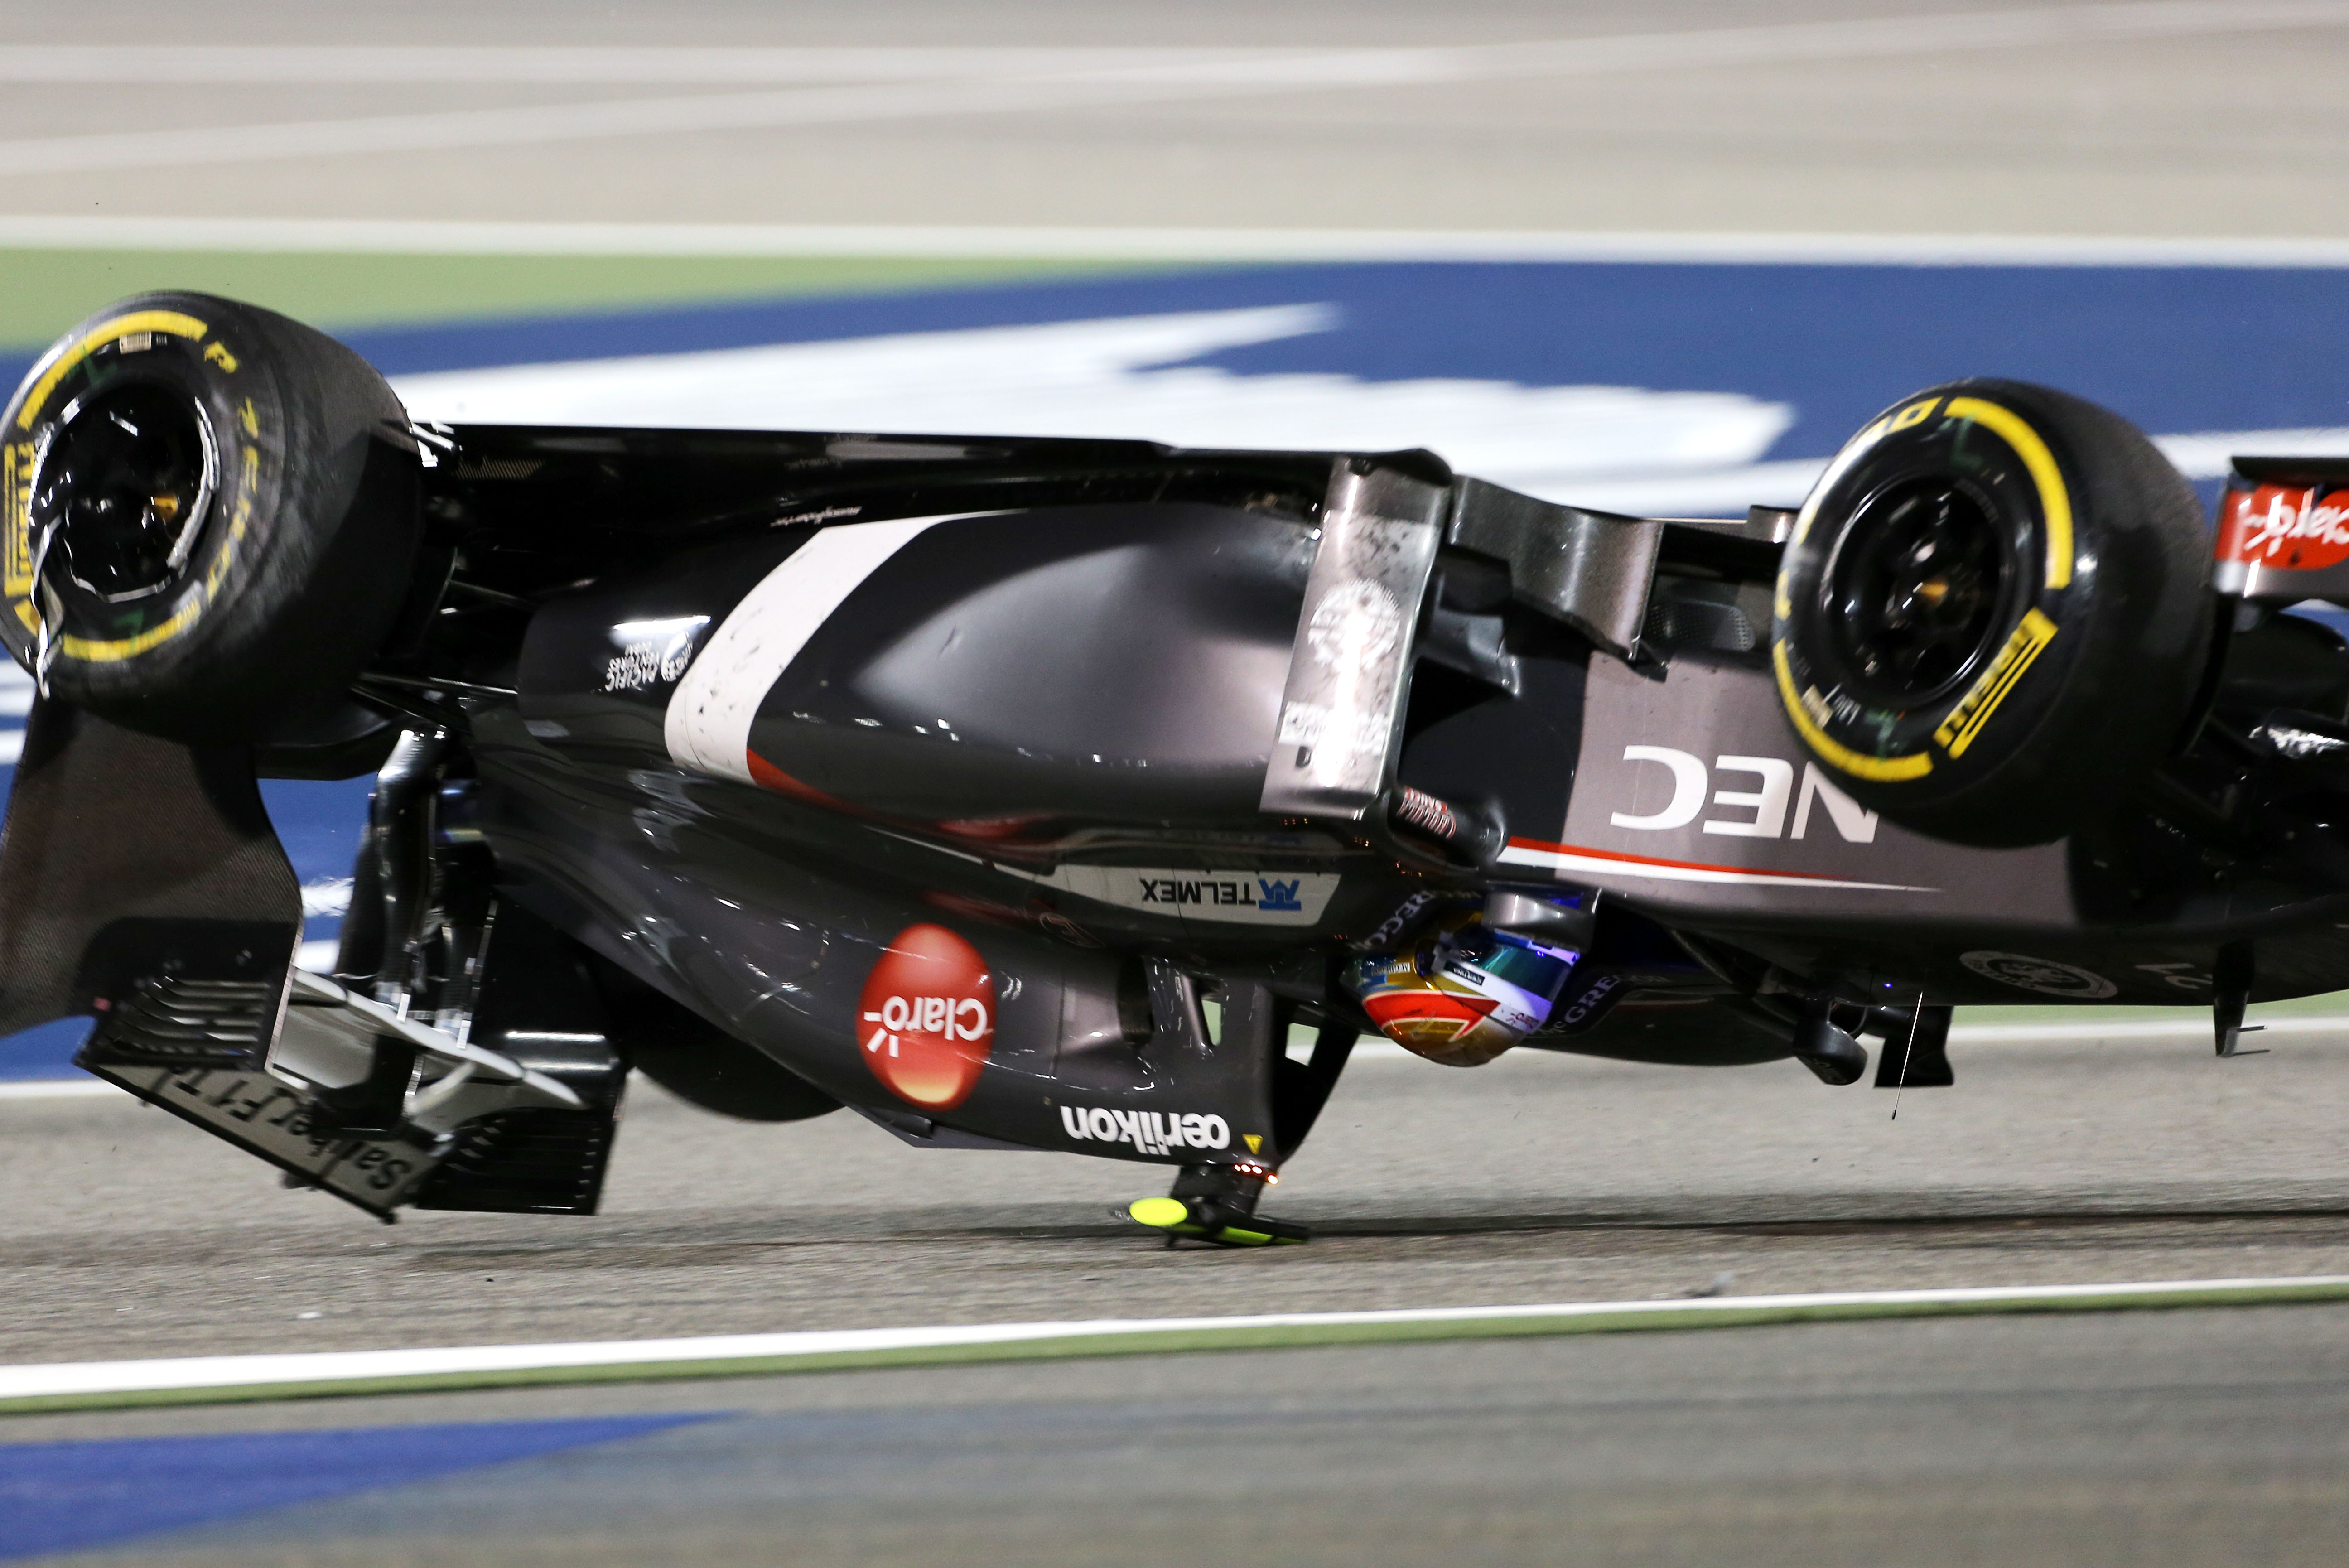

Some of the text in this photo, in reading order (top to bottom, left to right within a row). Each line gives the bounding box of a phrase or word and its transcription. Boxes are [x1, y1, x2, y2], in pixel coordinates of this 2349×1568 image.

[1610, 745, 1879, 844] NEC
[1138, 878, 1256, 907] TELMEX
[882, 995, 989, 1043] Claro
